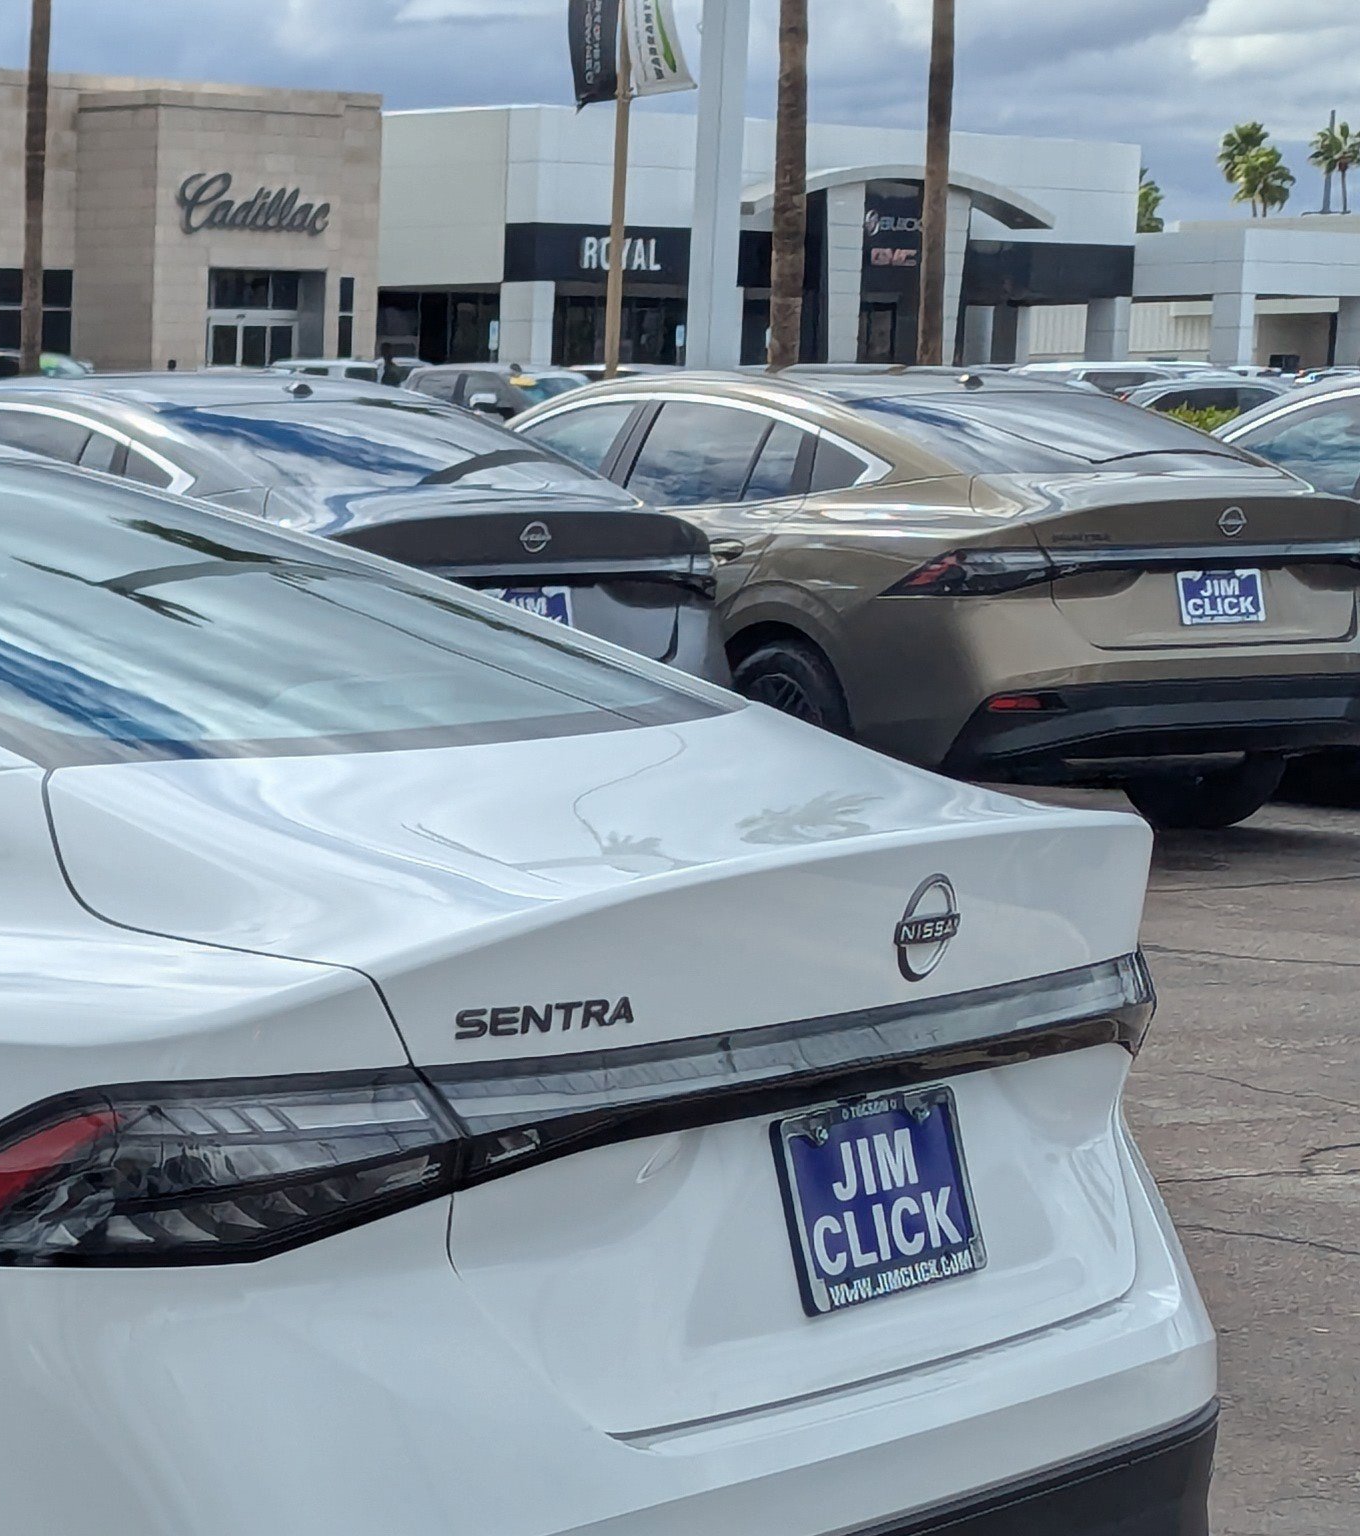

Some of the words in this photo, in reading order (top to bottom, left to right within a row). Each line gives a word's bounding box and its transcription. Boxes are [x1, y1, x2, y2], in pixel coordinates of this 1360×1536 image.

[643, 0, 665, 80] WARRANT
[175, 172, 330, 237] Cadillac
[1187, 596, 1256, 616] CLICK
[1200, 578, 1240, 597] JIM
[455, 996, 634, 1041] SENTRA
[832, 1127, 919, 1201] JIM
[813, 1186, 963, 1276] CLICK
[829, 1248, 973, 1307] WWW.JIMCLICK.COM
